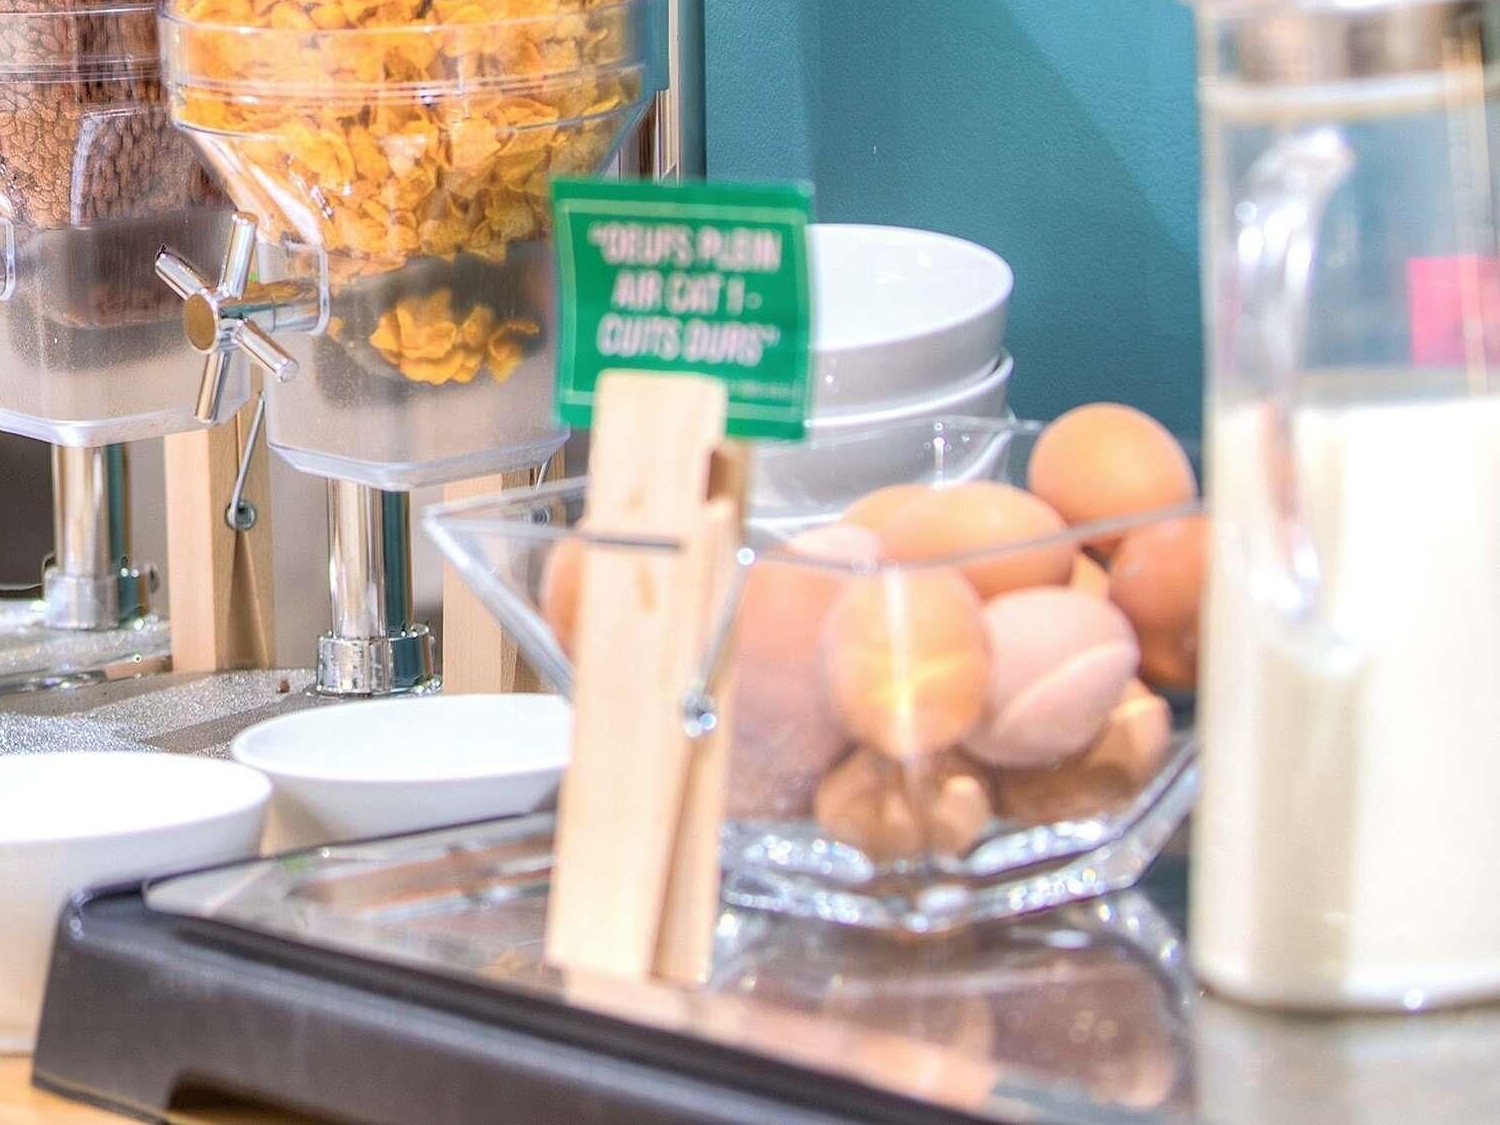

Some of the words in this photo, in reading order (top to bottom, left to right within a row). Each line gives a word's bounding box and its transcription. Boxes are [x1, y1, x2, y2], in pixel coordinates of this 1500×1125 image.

[697, 227, 782, 271] PLEIN
[613, 269, 663, 309] AIR
[666, 271, 723, 314] CAT
[597, 313, 681, 360] CUITS
